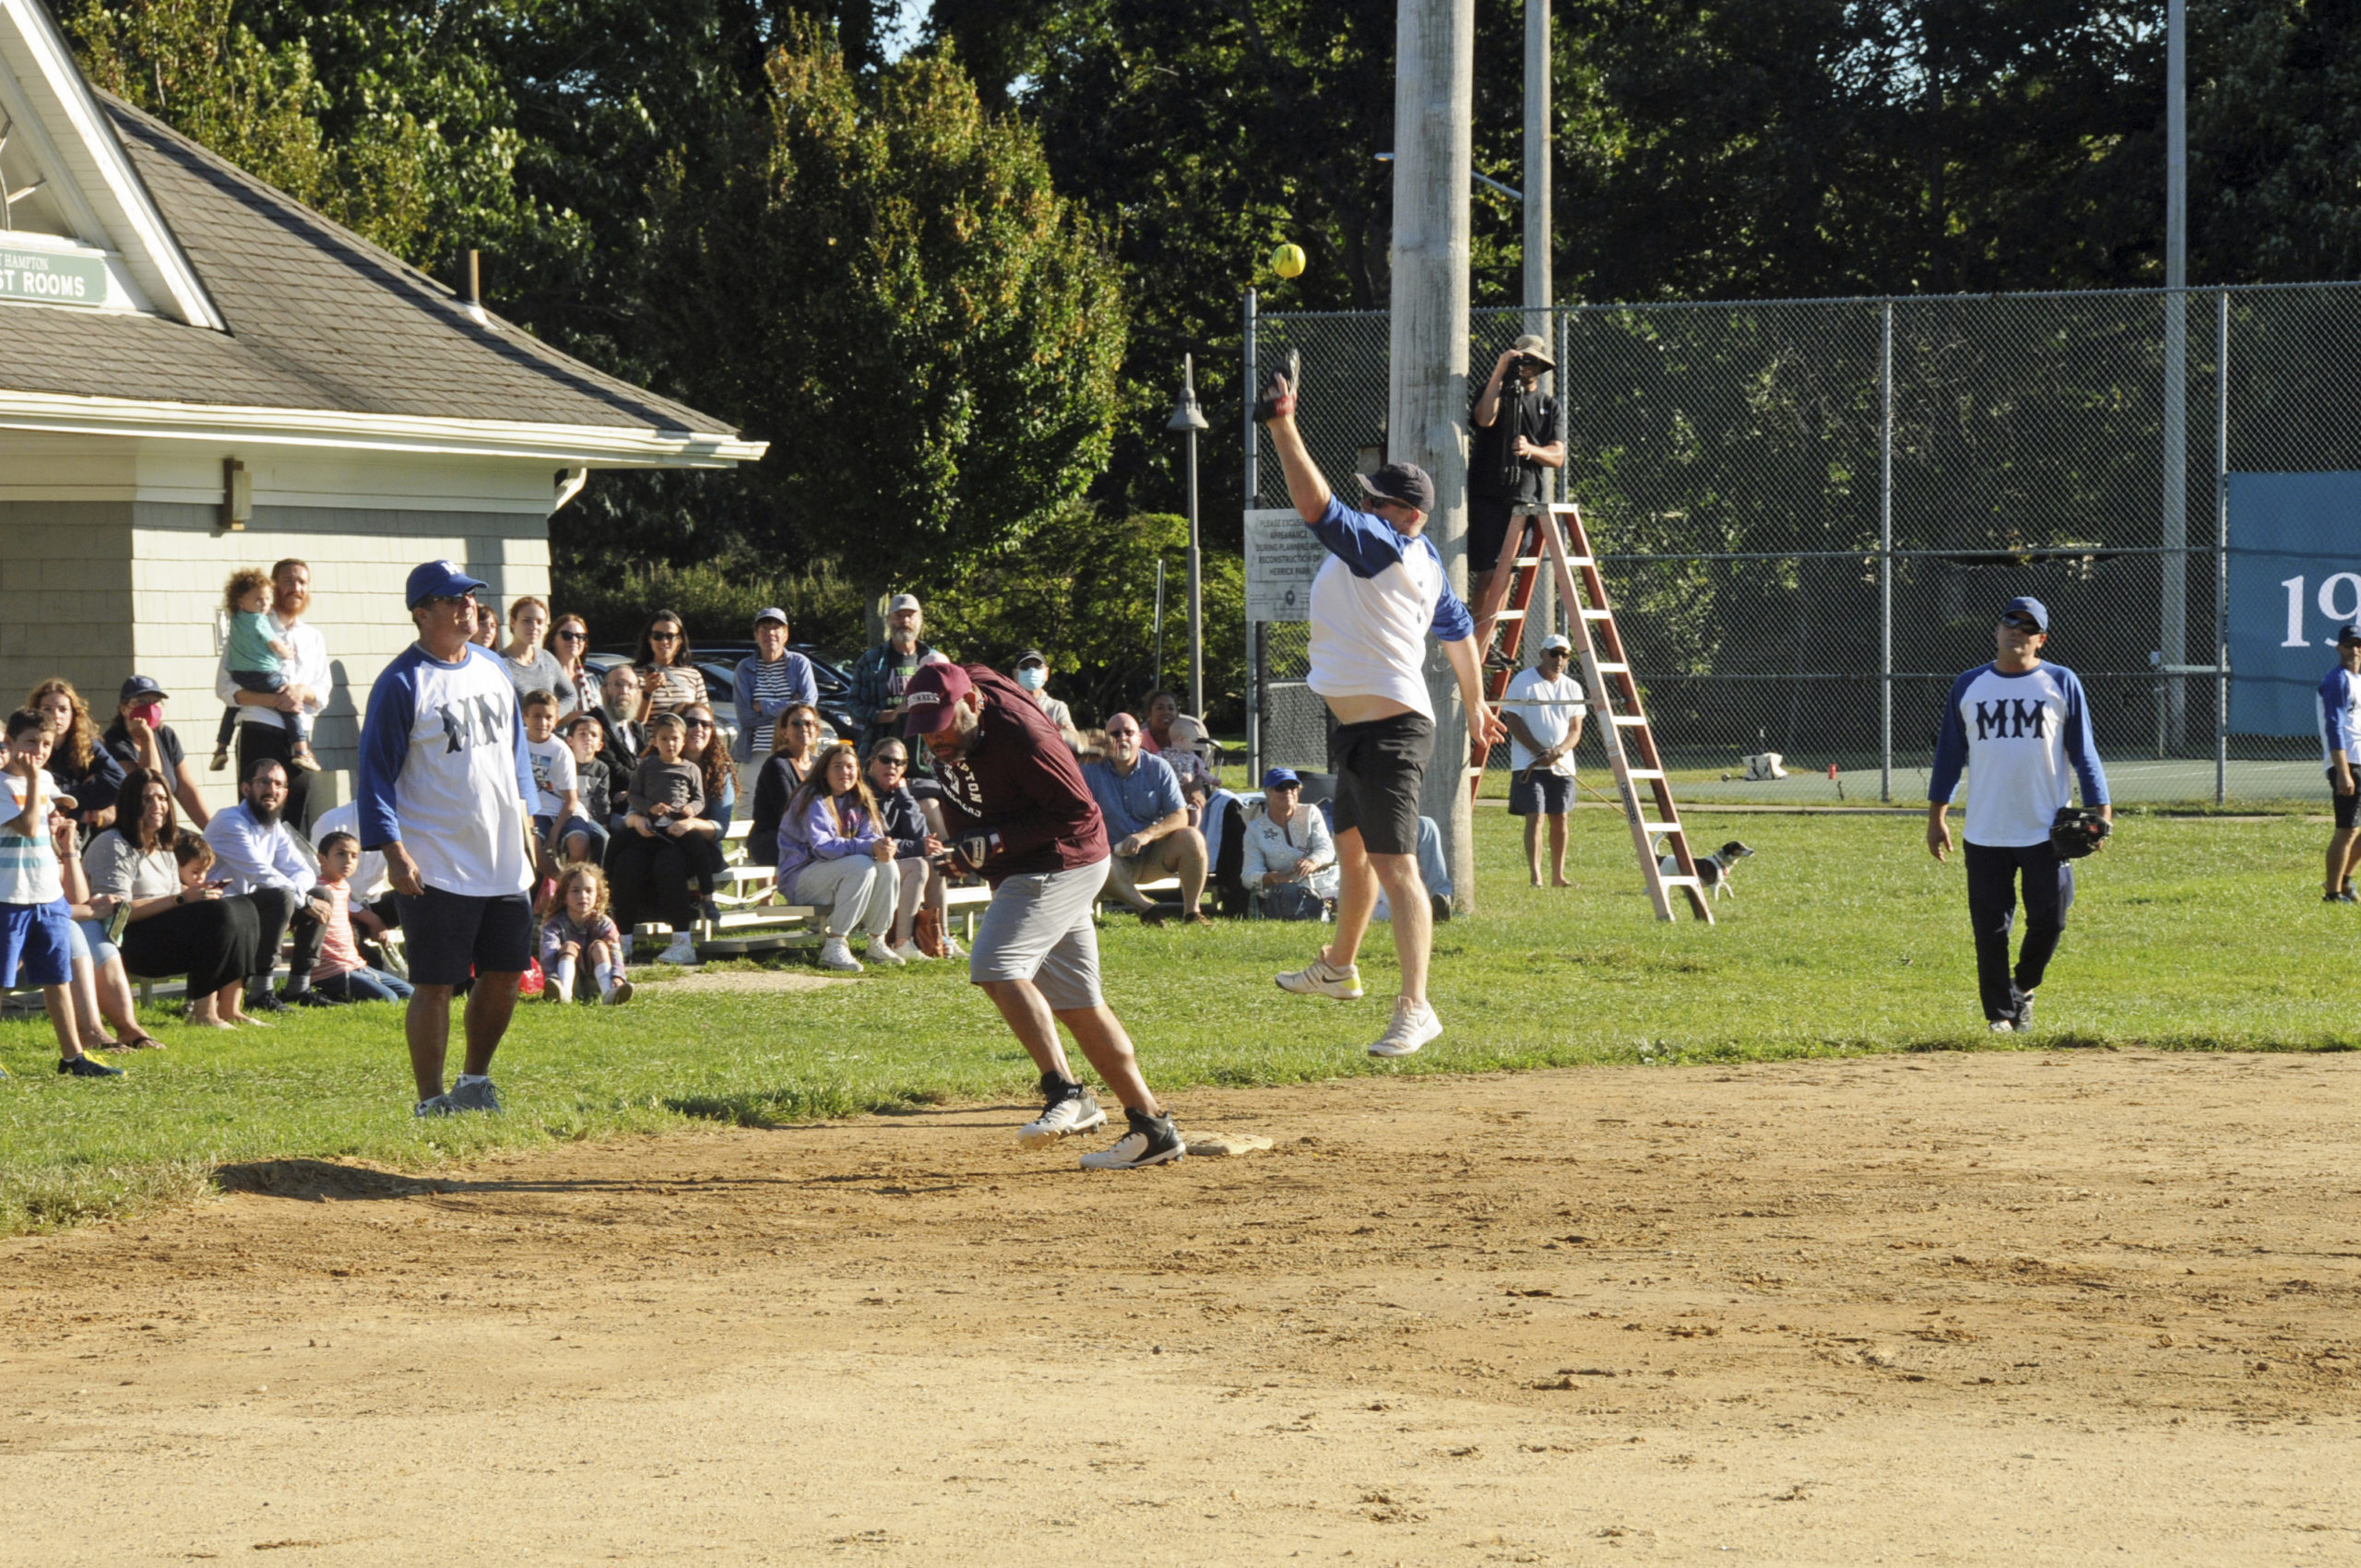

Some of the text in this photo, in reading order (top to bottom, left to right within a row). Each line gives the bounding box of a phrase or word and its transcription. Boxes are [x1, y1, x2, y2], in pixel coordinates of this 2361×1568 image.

[5, 254, 49, 270] HAMPTON
[22, 270, 86, 298] ROOMS
[1260, 518, 1281, 528] PLEASE
[1270, 530, 1308, 540] APPEARANCE
[1255, 543, 1277, 552] DURING
[1279, 542, 1310, 552] PLANNING
[1259, 554, 1311, 564] RECONSTRUCTION
[1269, 566, 1312, 576] HERRICK PARK
[896, 666, 916, 676] THE
[1975, 698, 2047, 741] MM
